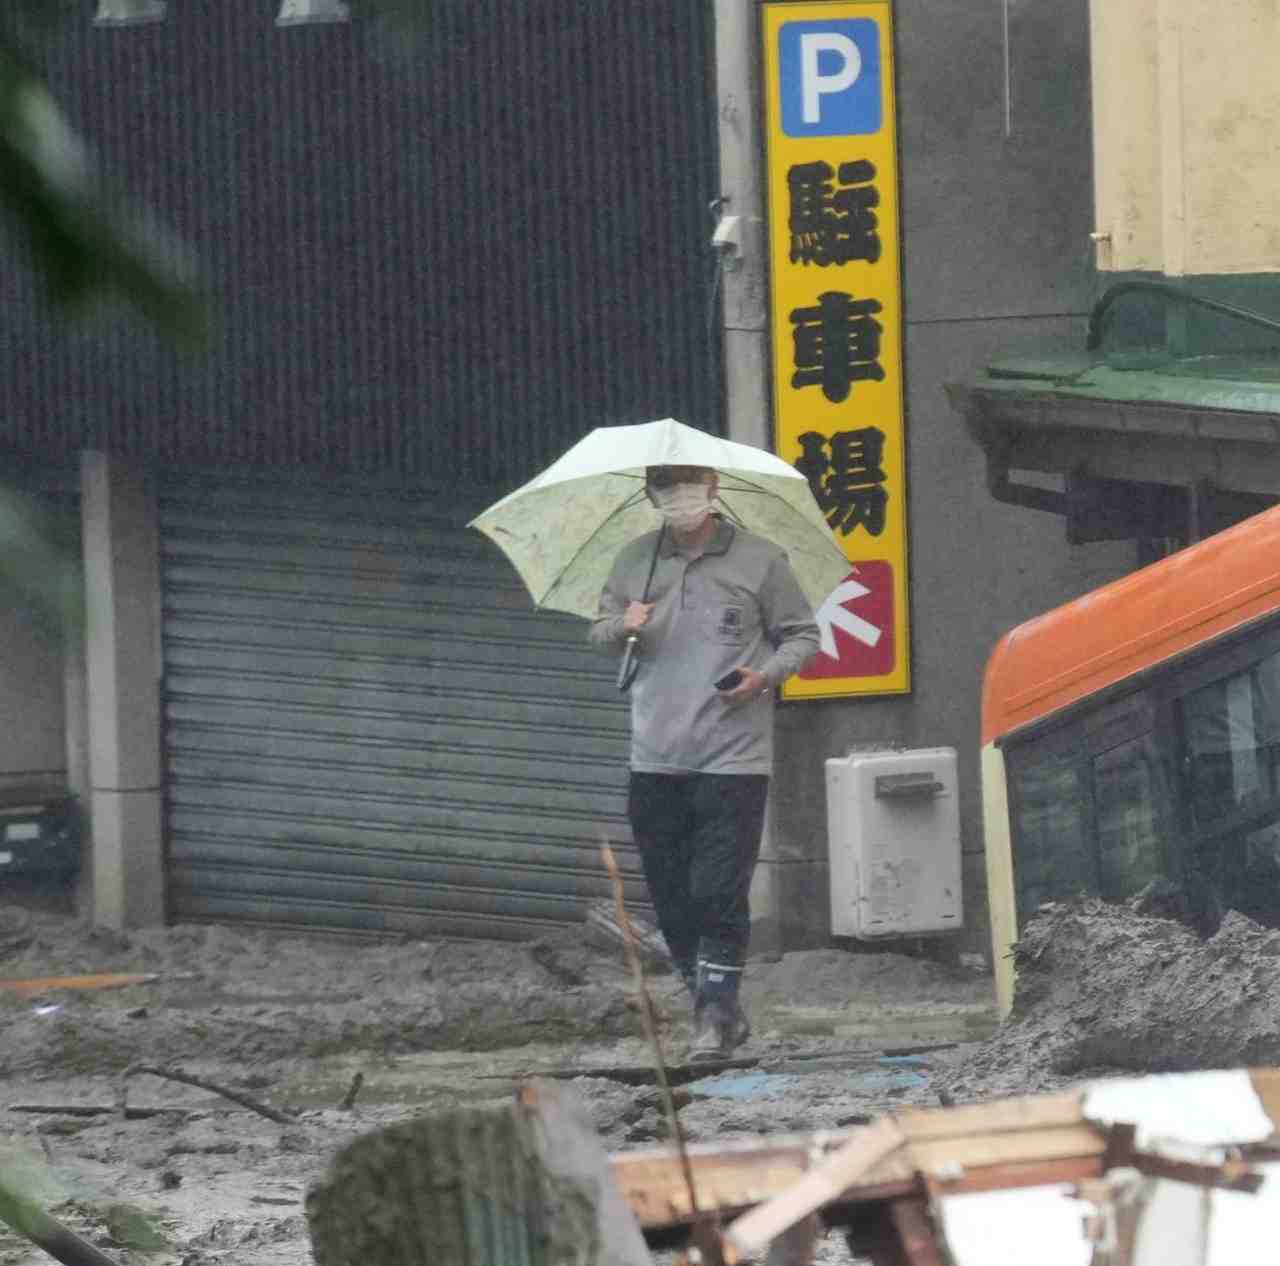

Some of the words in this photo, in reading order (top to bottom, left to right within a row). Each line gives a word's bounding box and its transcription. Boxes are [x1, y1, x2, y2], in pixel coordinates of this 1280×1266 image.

[801, 32, 861, 123] P
[787, 160, 887, 540] 駐車場
